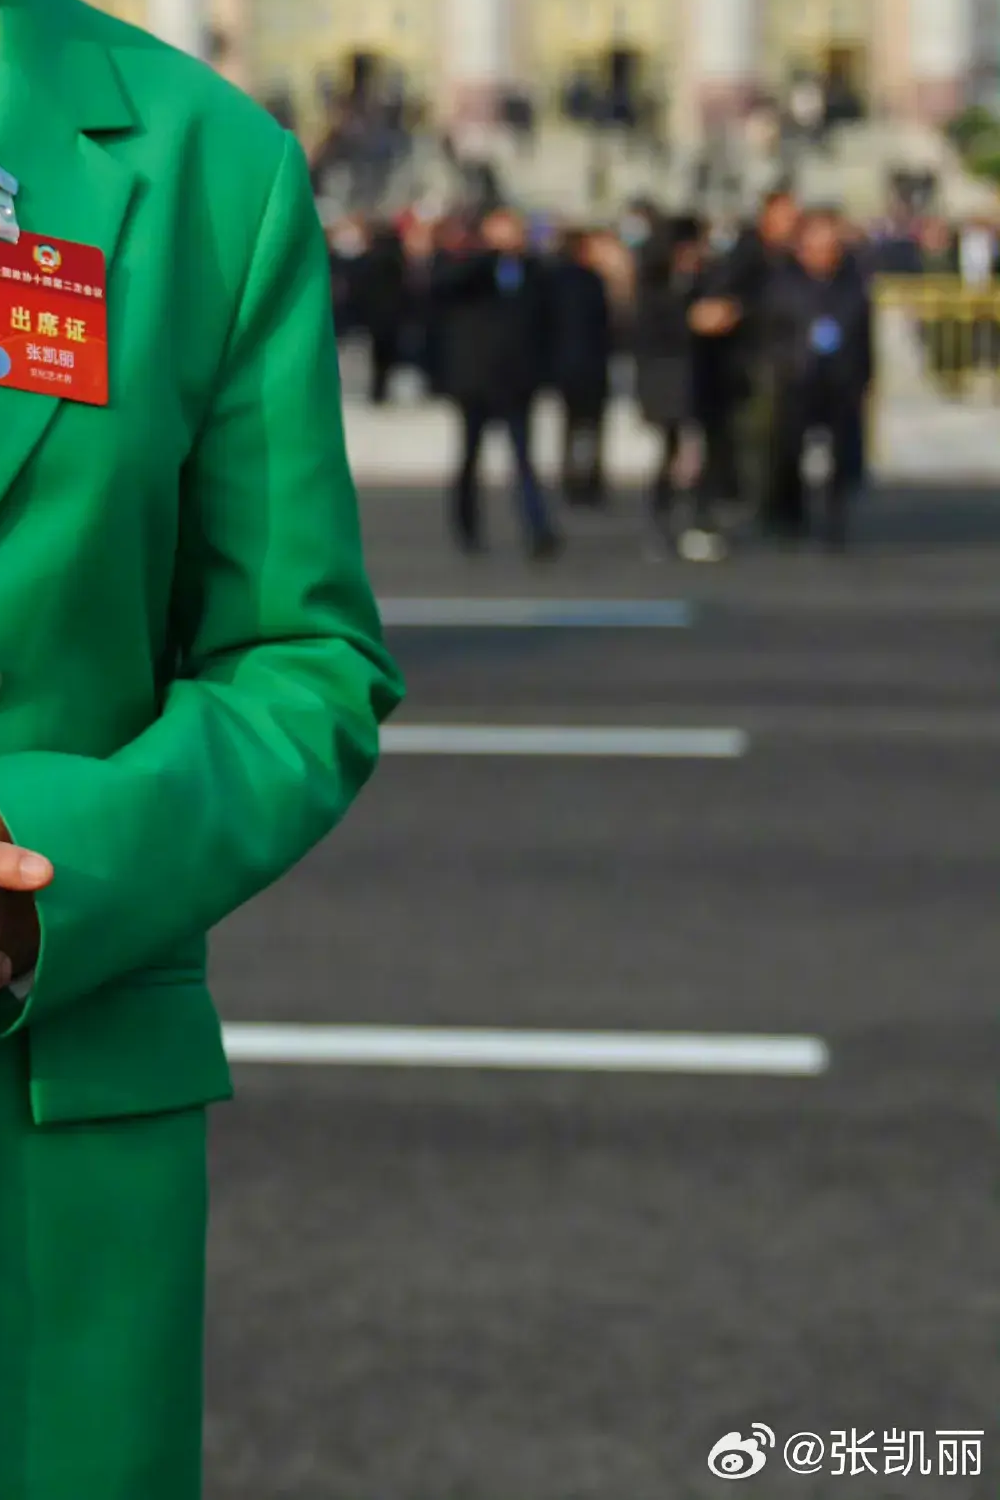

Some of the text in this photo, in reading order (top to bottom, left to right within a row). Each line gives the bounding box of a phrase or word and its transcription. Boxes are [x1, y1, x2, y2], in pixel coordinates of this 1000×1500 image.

[11, 306, 87, 343] 出席证
[26, 342, 75, 368] 张凯丽
